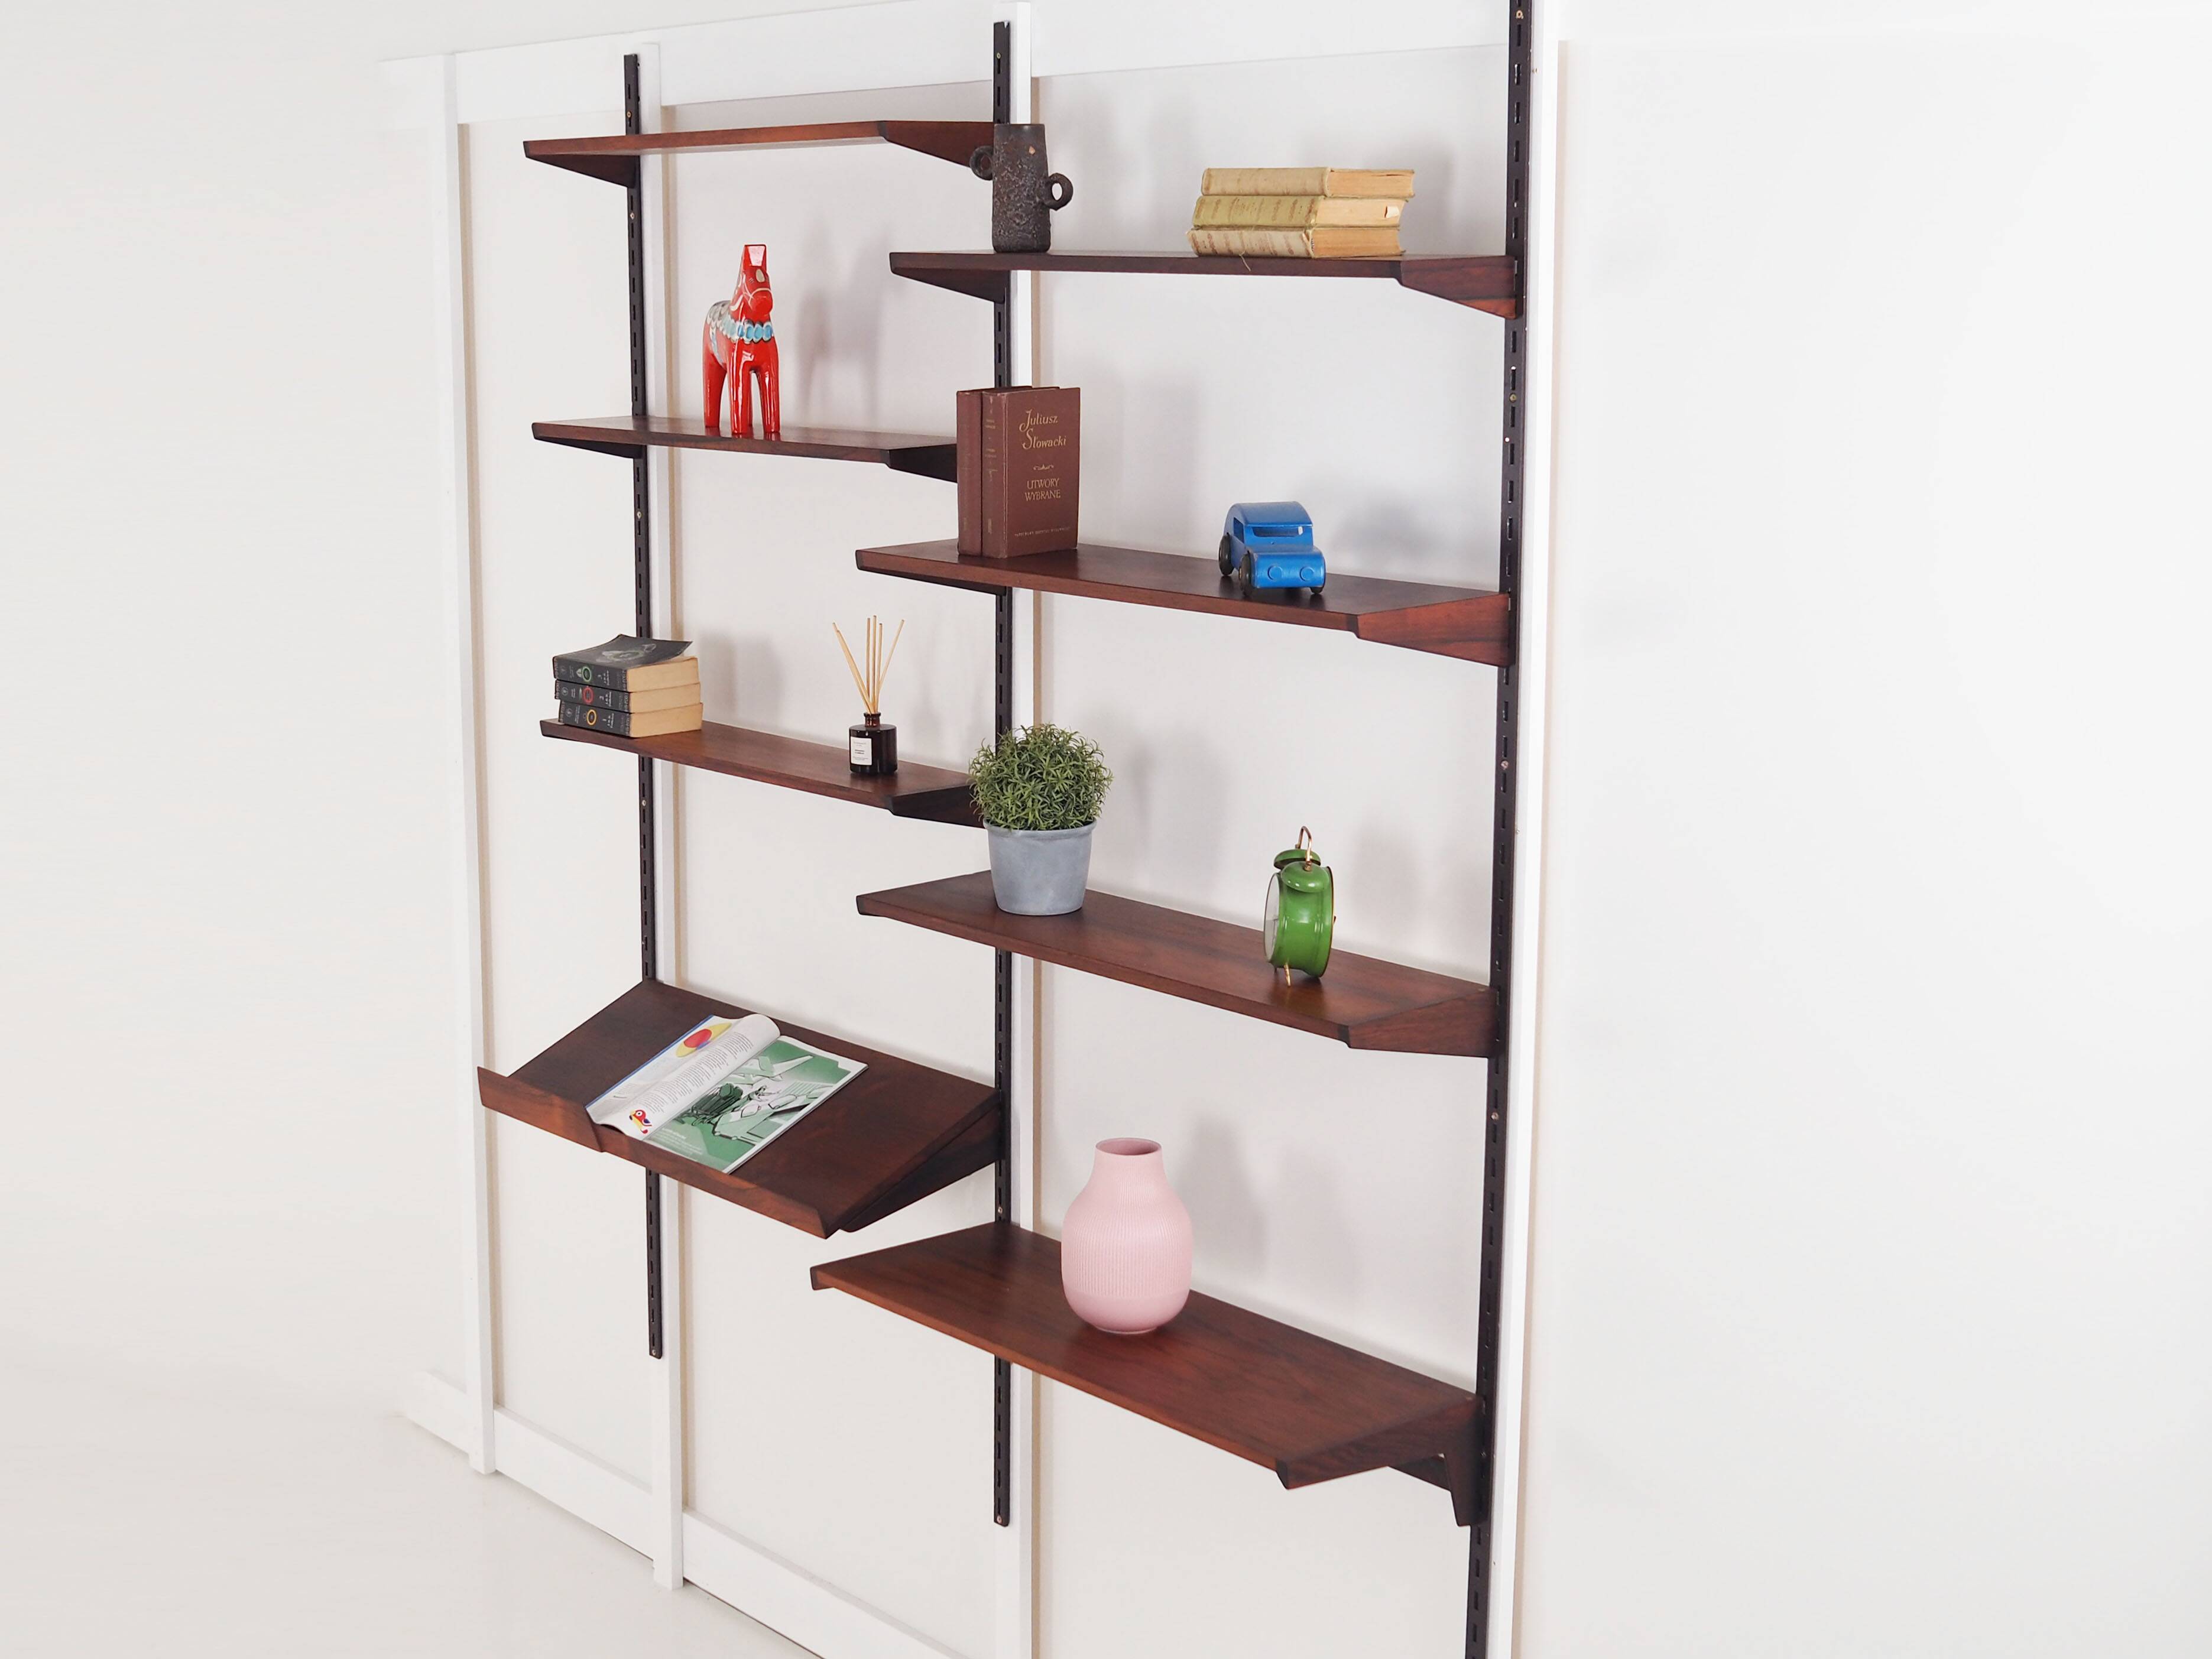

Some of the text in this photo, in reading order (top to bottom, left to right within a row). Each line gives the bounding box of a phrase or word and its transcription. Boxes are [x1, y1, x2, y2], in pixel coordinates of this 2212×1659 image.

[1019, 408, 1058, 432] Juliusz
[1022, 428, 1066, 450] Słowacki
[1027, 478, 1059, 489] UTWORY
[1024, 489, 1061, 502] WYBRANE
